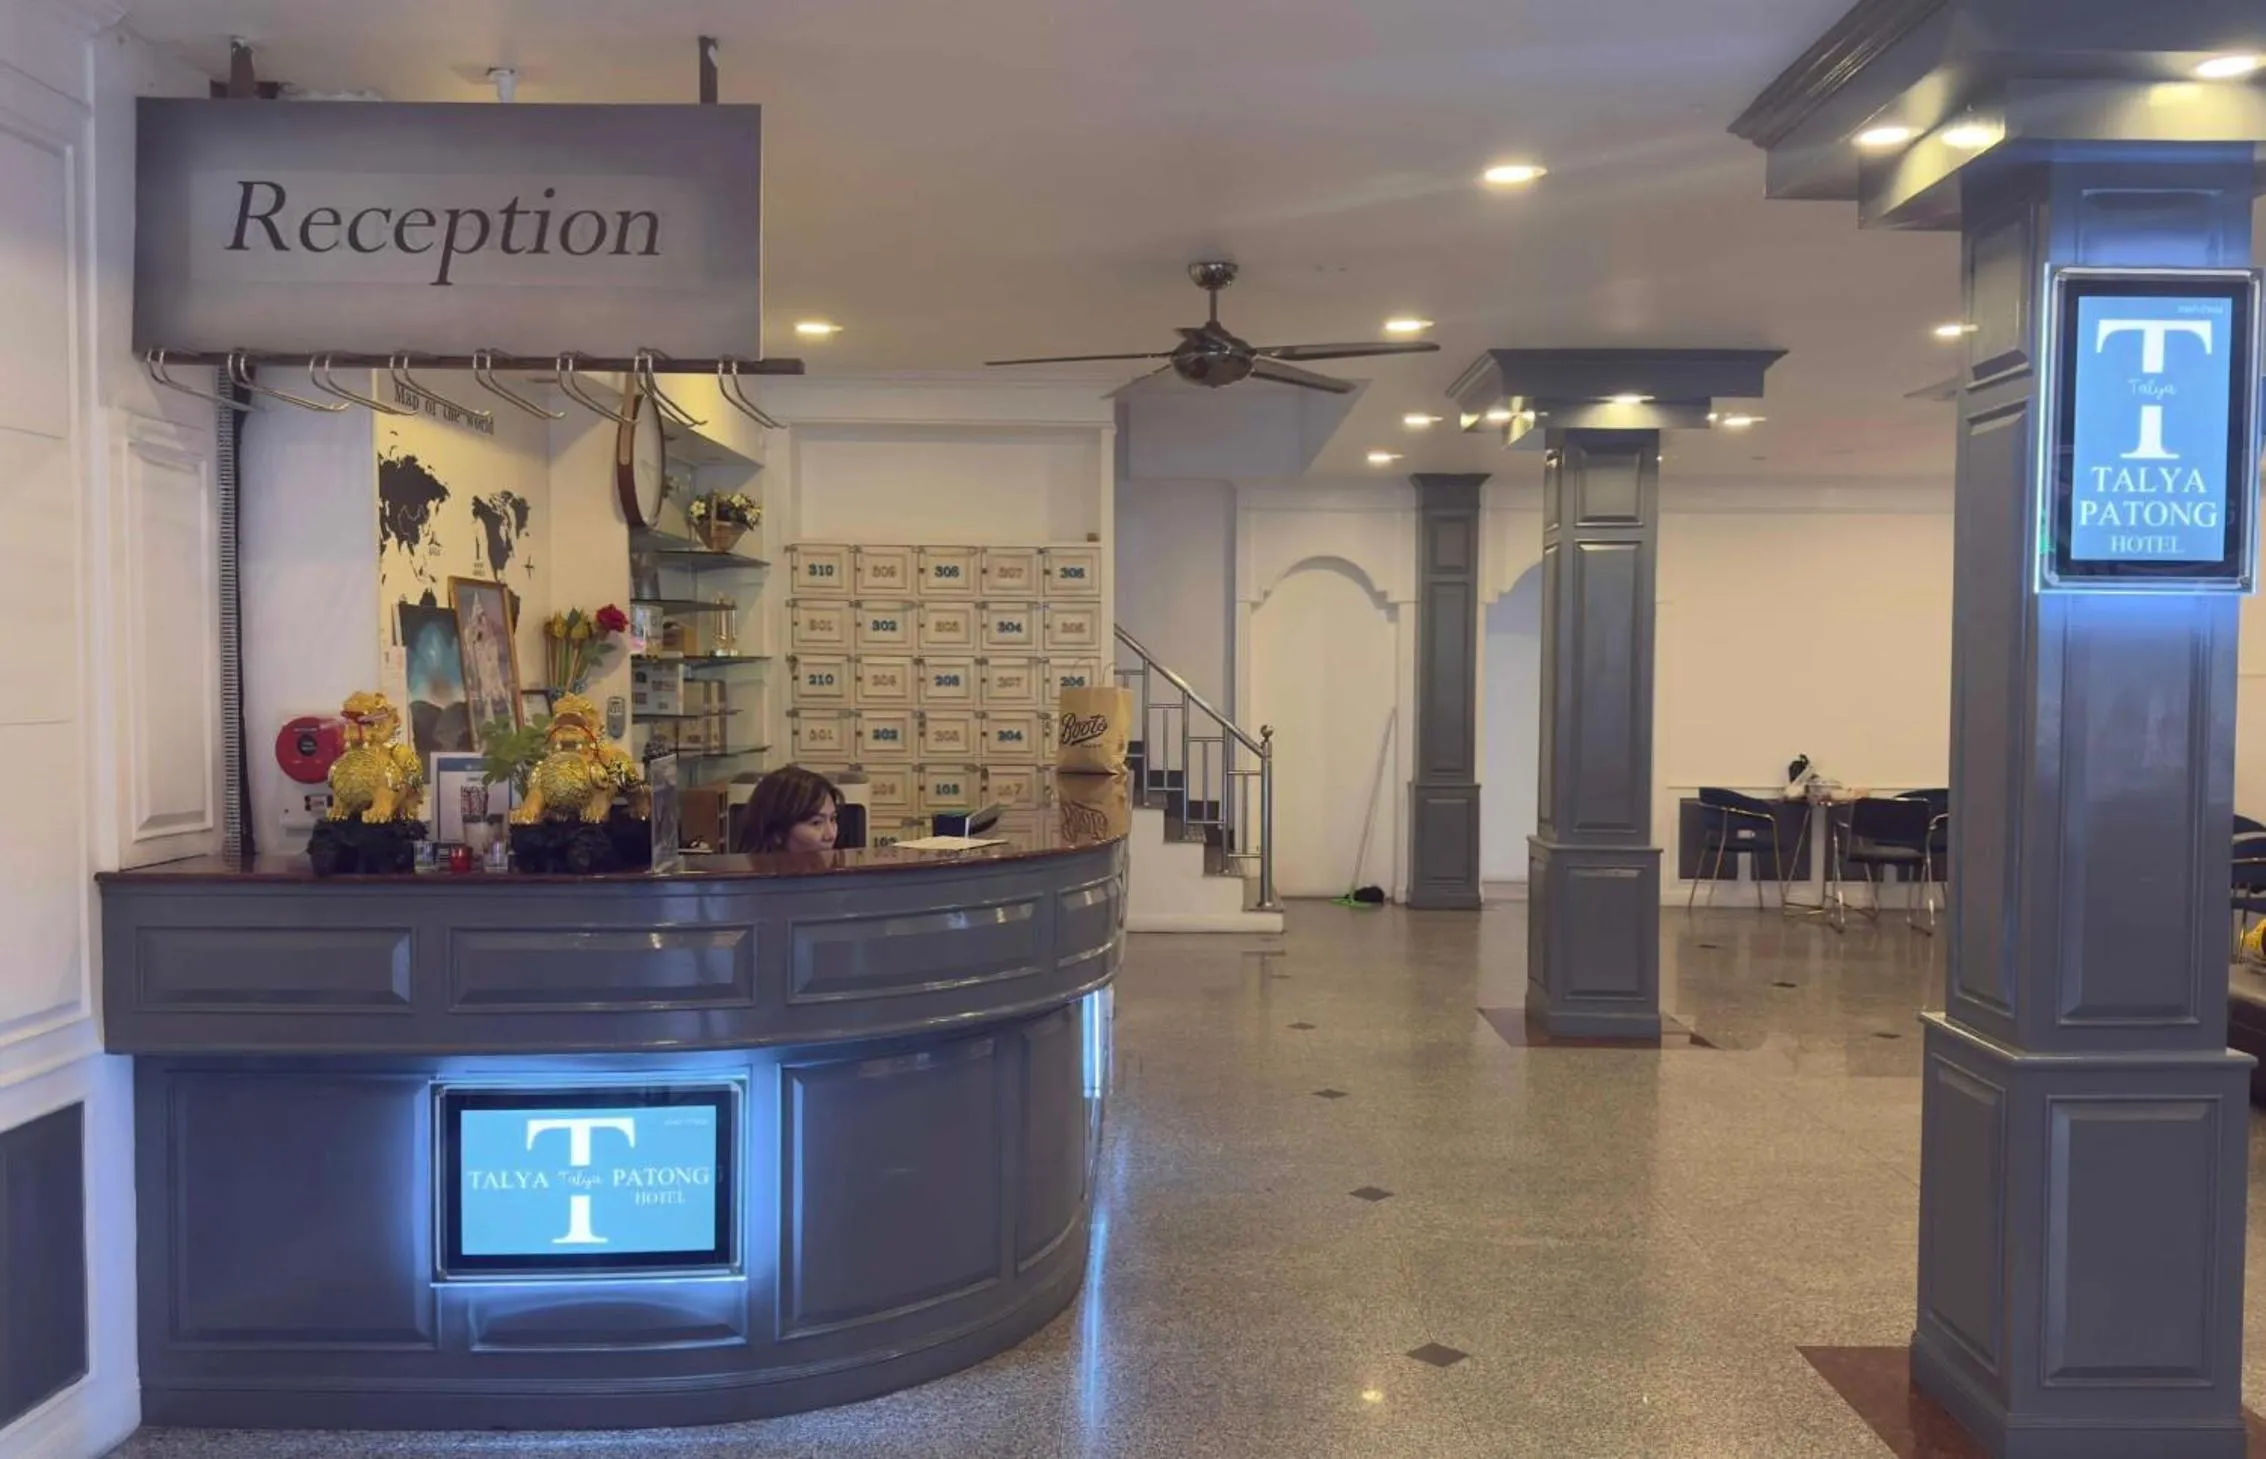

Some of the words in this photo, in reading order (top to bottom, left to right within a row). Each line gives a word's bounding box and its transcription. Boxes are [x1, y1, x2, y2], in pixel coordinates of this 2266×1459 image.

[225, 179, 661, 287] Reception
[394, 382, 419, 410] Map
[2096, 319, 2212, 459] T
[2091, 466, 2206, 493] TALYA
[2079, 500, 2217, 528] PATONG
[2110, 535, 2185, 554] HOTEL
[809, 564, 833, 576] 310
[872, 621, 897, 631] 302
[997, 622, 1022, 632] 304
[809, 674, 833, 685] 210
[872, 729, 898, 740] 202
[997, 730, 1022, 741] 204
[1061, 713, 1108, 746] Boots
[936, 784, 960, 794] 108
[467, 1171, 549, 1190] TALYA
[612, 1167, 710, 1187] PATONG
[526, 1117, 635, 1244] T
[635, 1190, 686, 1206] HOTEL
